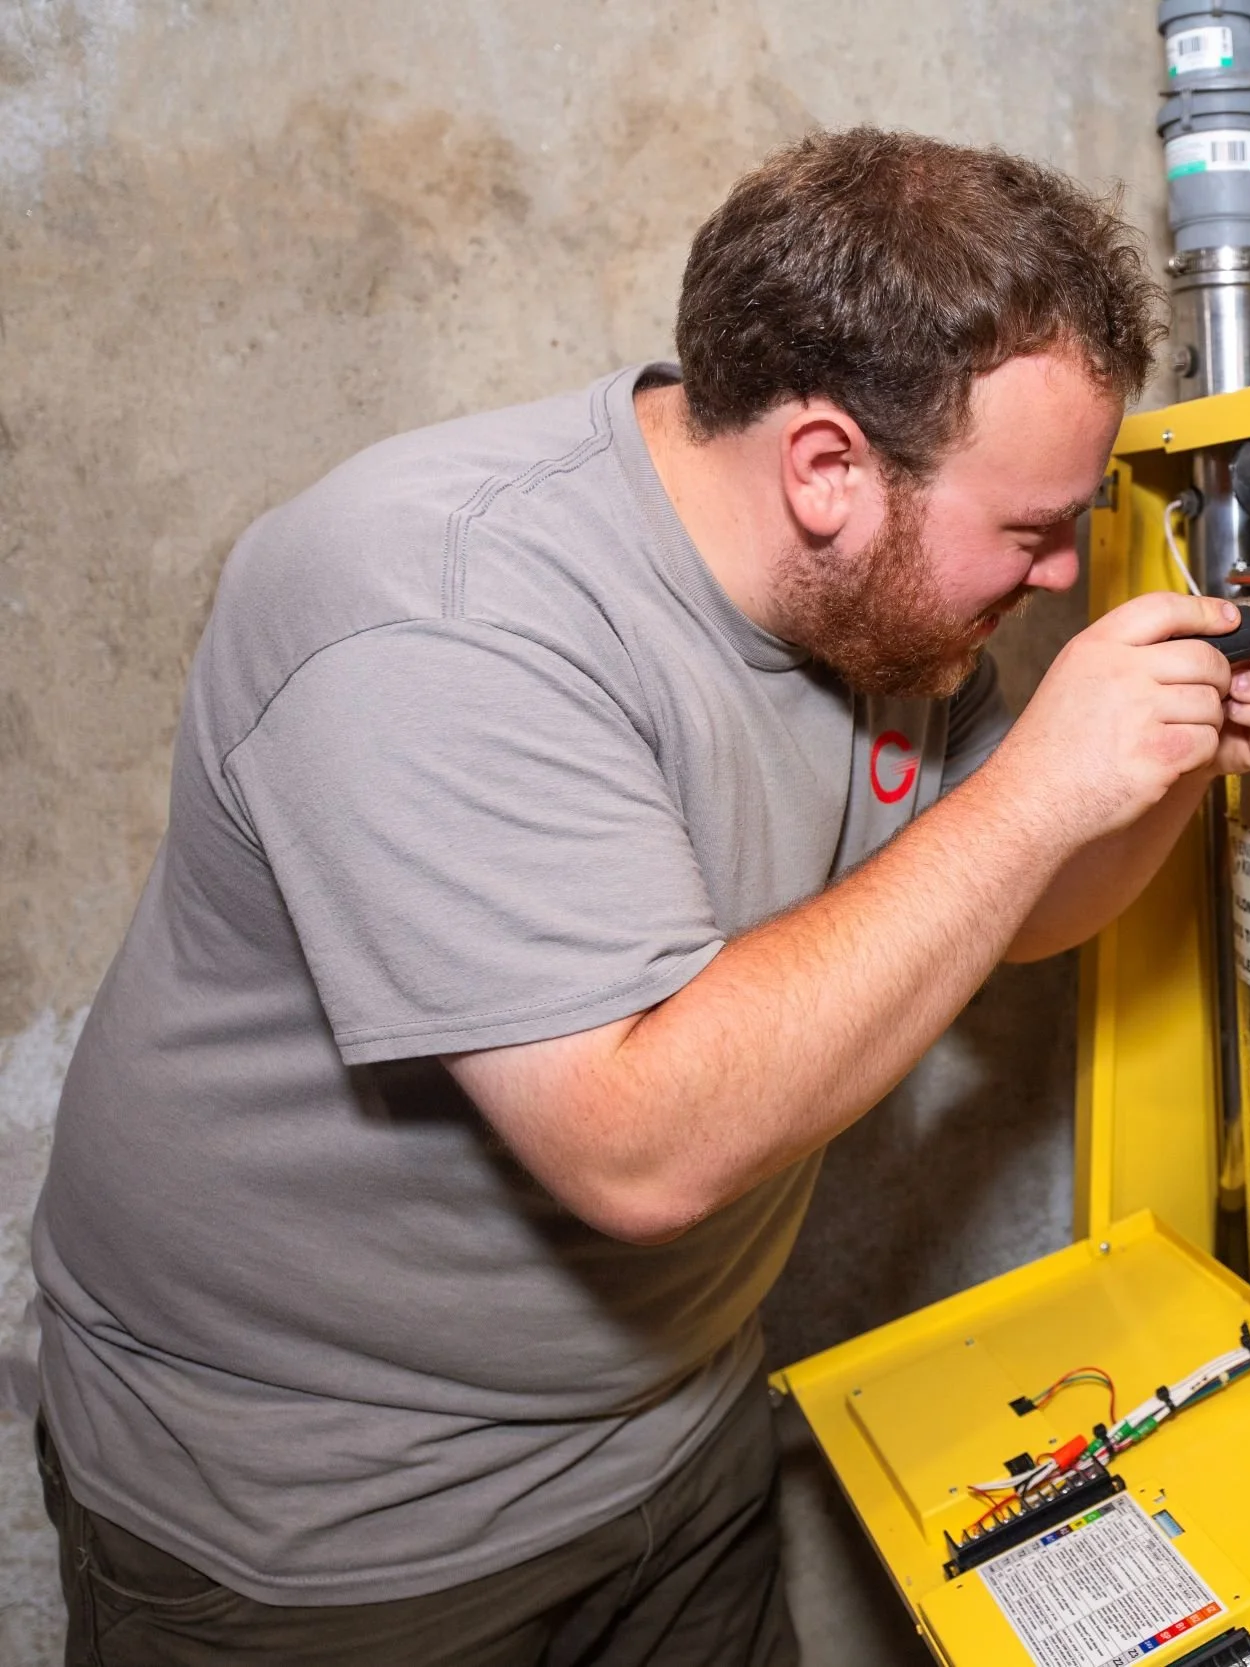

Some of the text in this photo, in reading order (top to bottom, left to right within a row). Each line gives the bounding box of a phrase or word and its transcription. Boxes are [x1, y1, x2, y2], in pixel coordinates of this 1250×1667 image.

[1160, 1631, 1172, 1639] SP
[1128, 1648, 1139, 1659] Z3
[1113, 1658, 1124, 1667] Z2
